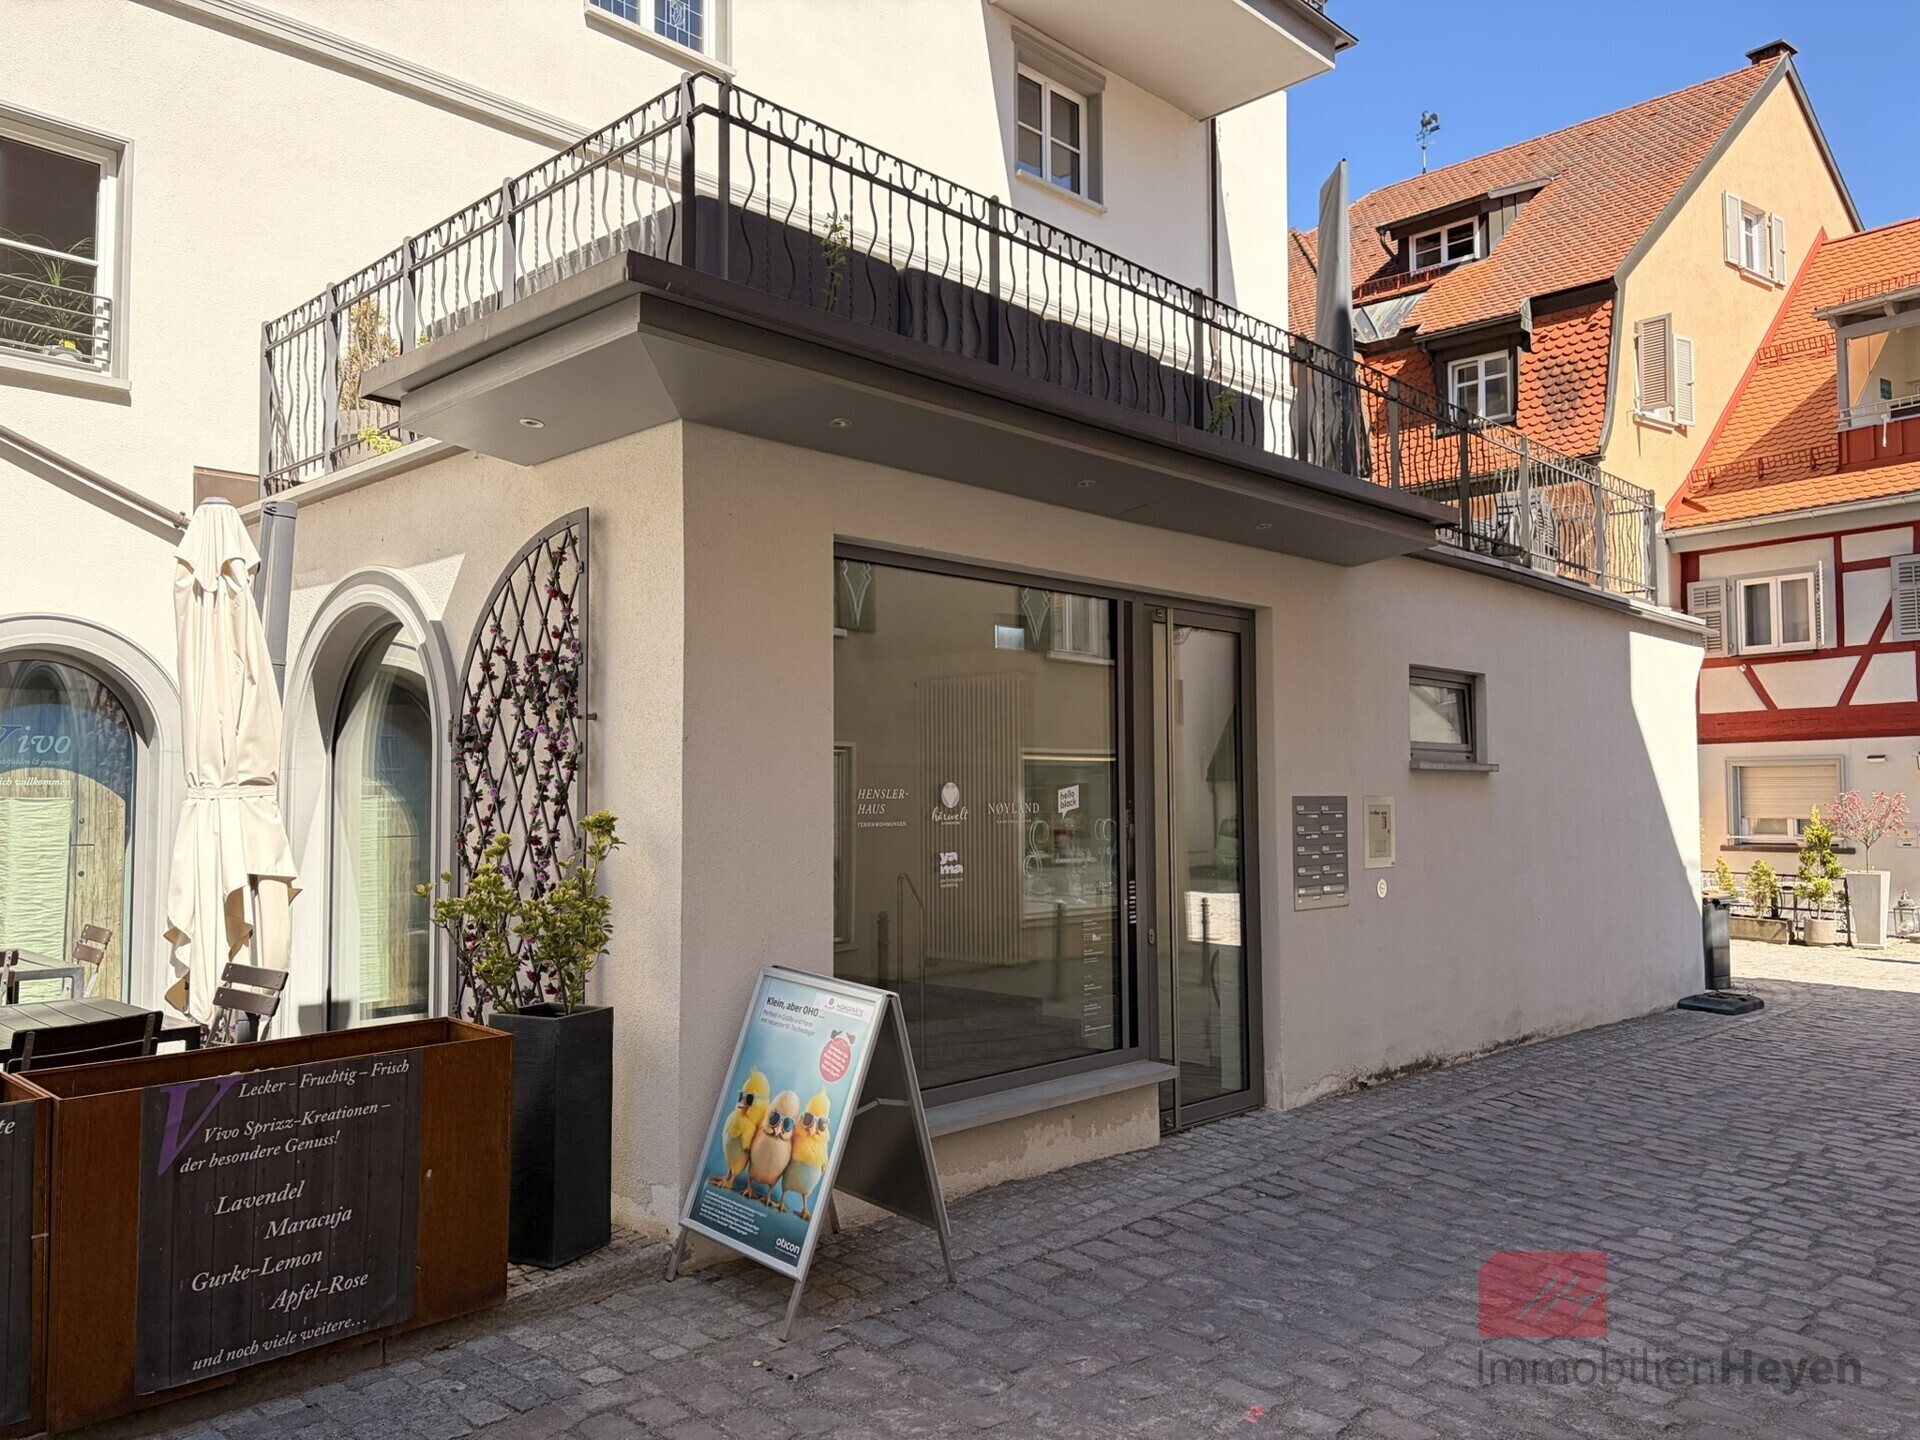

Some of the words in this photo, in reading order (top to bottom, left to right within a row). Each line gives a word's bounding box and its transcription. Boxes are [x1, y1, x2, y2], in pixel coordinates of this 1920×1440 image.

[15, 776, 71, 786] willkommen
[857, 788, 909, 800] HENSLER-
[1060, 789, 1075, 800] hello
[857, 803, 886, 815] HAUS
[988, 802, 1040, 815] NØYLAND
[766, 996, 785, 1009] Klein,
[786, 1001, 802, 1013] aber
[802, 1005, 819, 1017] OHO
[238, 1079, 286, 1098] Lecker
[299, 1067, 357, 1089] Fruchtig
[370, 1059, 410, 1078] Frisch
[204, 1127, 240, 1144] Vivo
[244, 1102, 378, 1141] Sprizz-Kreationen
[180, 1155, 205, 1174] der
[209, 1143, 281, 1169] besondere
[285, 1130, 341, 1153] Genuss!
[214, 1180, 306, 1216] Lavendel
[264, 1206, 353, 1240] Maracuja
[776, 1238, 800, 1255] oticon
[191, 1250, 323, 1292] Gurke-Lemon
[269, 1273, 369, 1313] Apfel-Rose
[192, 1349, 223, 1371] und
[226, 1340, 259, 1362] noch
[262, 1331, 297, 1351] viele
